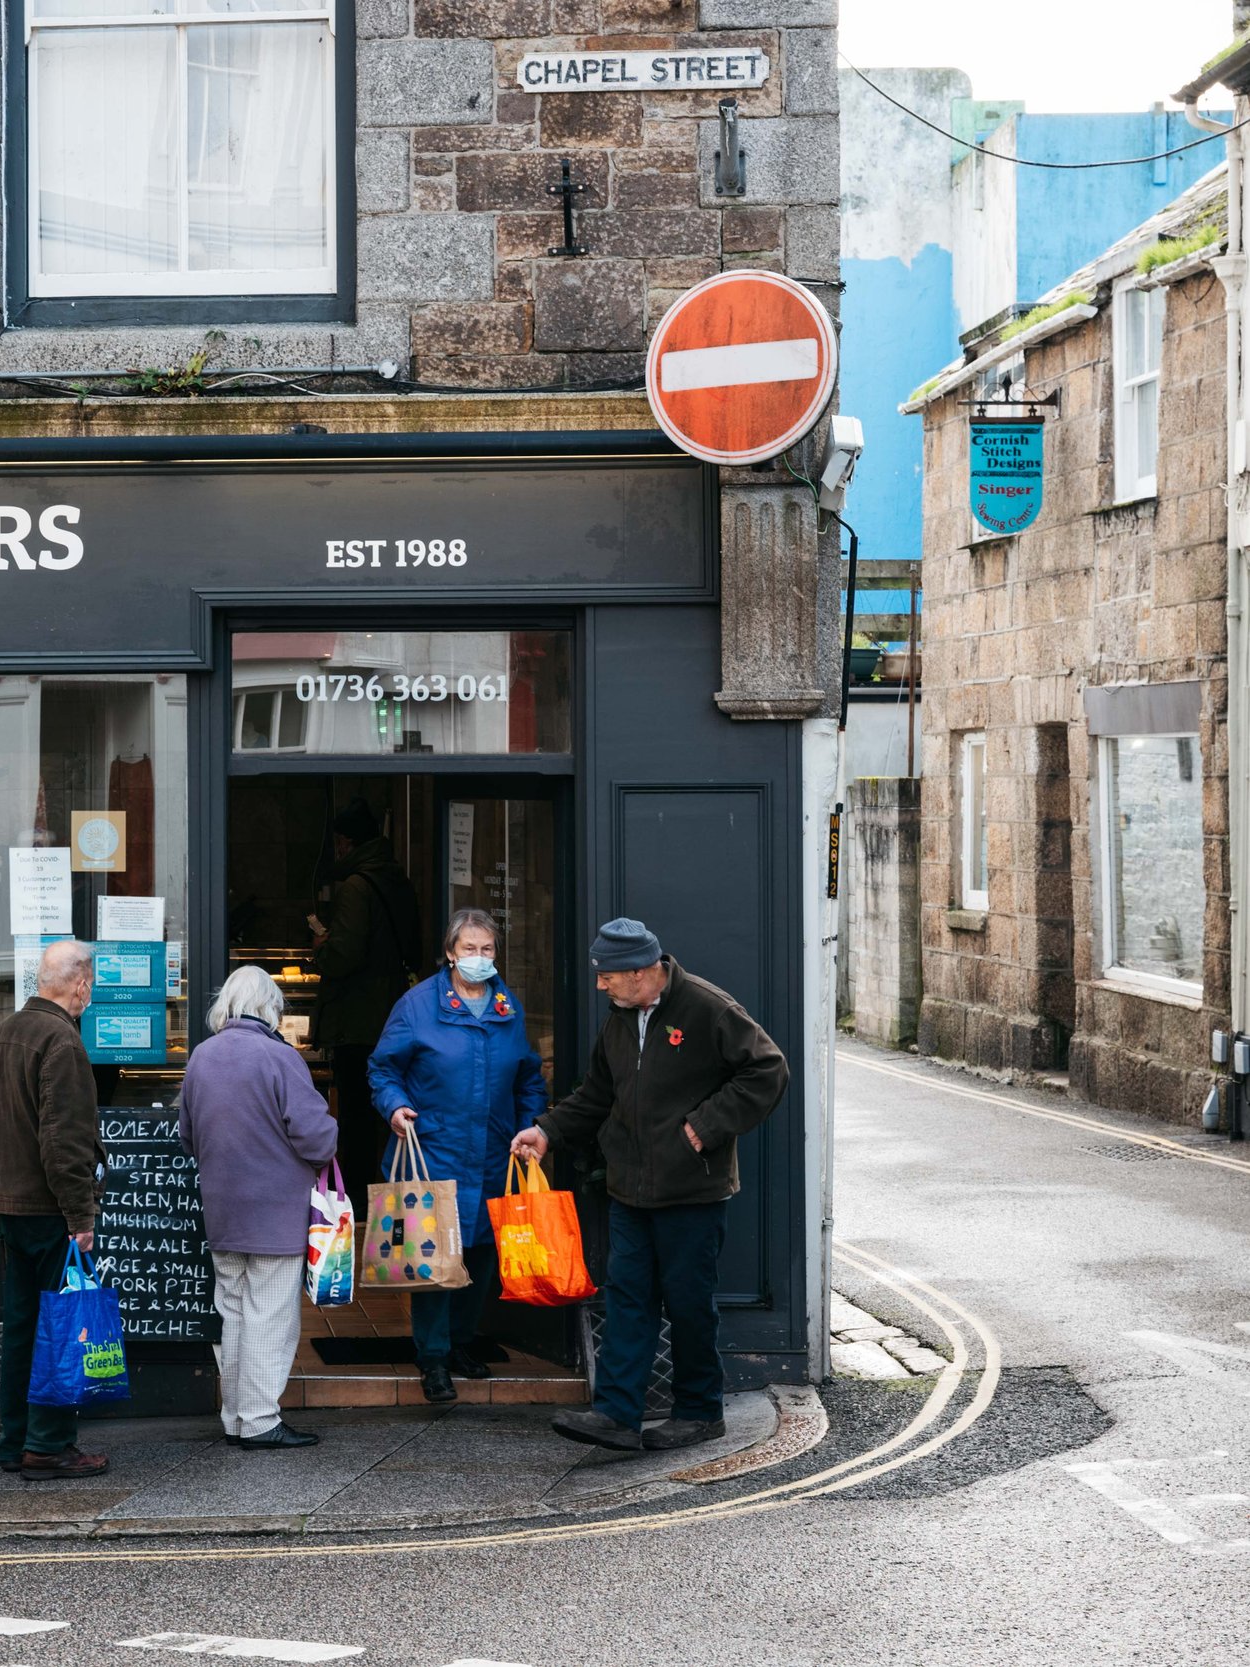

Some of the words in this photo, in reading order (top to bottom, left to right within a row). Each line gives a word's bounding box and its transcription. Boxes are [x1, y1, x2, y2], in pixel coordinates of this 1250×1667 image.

[524, 58, 638, 85] CHAPEL
[650, 55, 761, 82] STREET
[971, 434, 1029, 446] Cornish
[981, 446, 1022, 457] Stitch
[987, 457, 1041, 470] Designs
[978, 484, 1034, 497] Singer
[977, 503, 1005, 530] Sewing
[1008, 503, 1034, 527] Centre
[326, 540, 387, 568] EST
[395, 539, 468, 567] 1988
[296, 674, 384, 702] 01736
[392, 674, 448, 702] 363
[457, 674, 509, 702] 061
[153, 1120, 181, 1138] MA
[107, 1153, 198, 1170] ADITION
[128, 1172, 187, 1188] STEAK
[100, 1191, 173, 1214] ICKEN,
[177, 1195, 204, 1212] HA
[102, 1212, 197, 1231] MUSHROOM
[98, 1234, 140, 1252] TEAK
[158, 1239, 192, 1254] ALE
[95, 1256, 142, 1273] ARGE
[161, 1261, 209, 1278] SMALL
[111, 1277, 158, 1294] PORK
[165, 1278, 206, 1295] PIE
[165, 1299, 217, 1314] SMALL
[83, 1340, 103, 1354] The
[86, 1356, 112, 1370] Green
